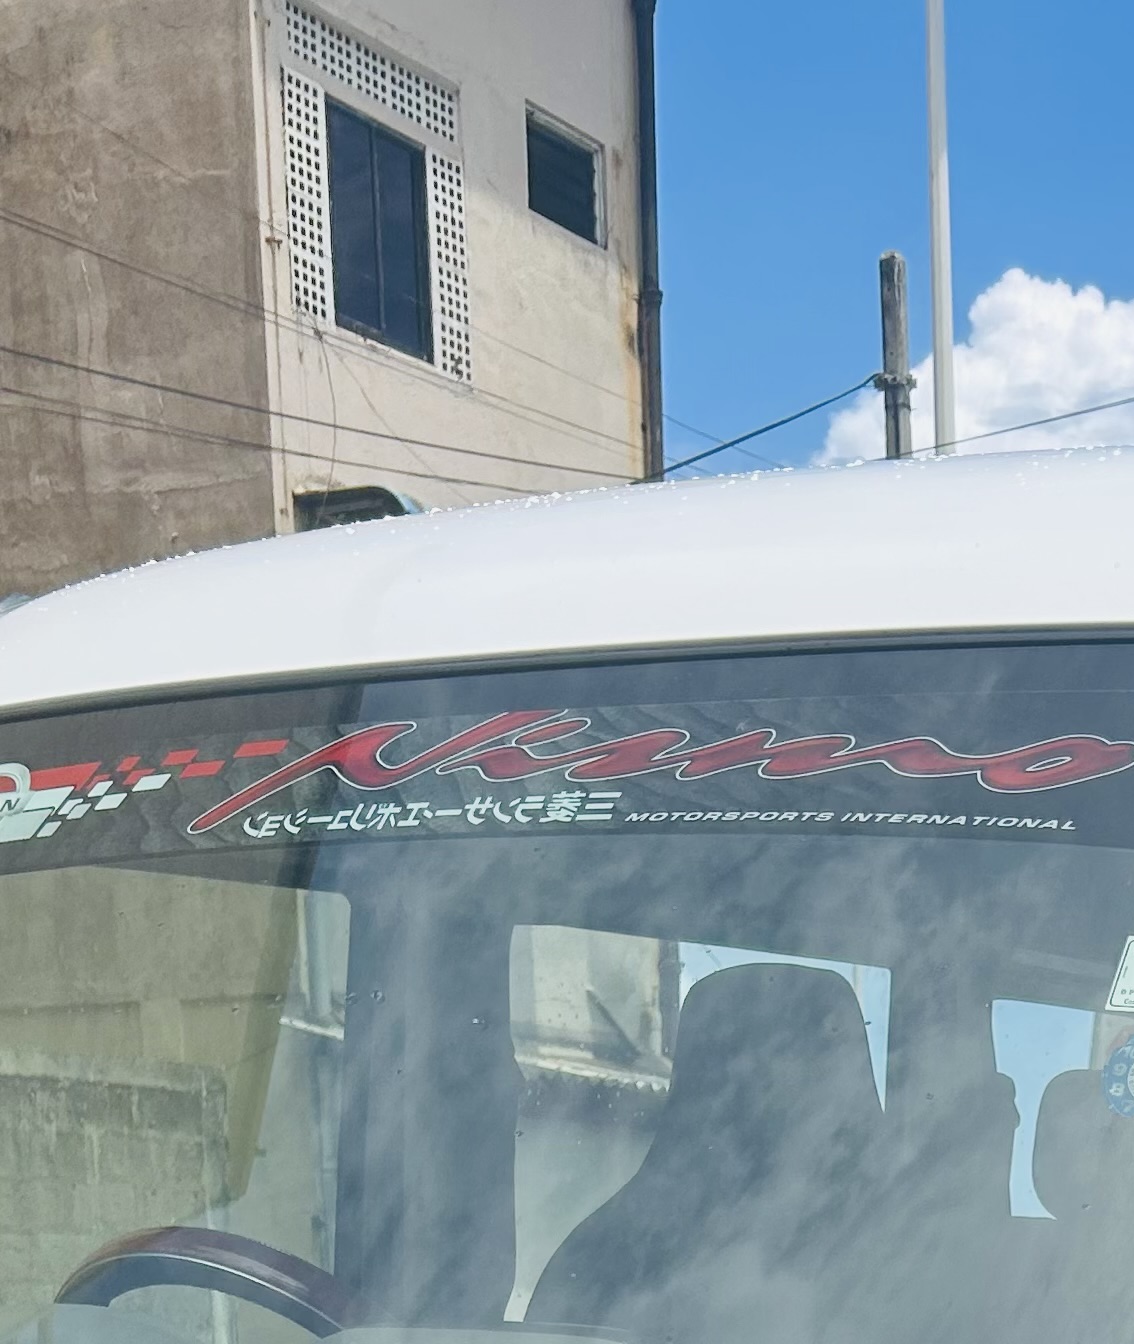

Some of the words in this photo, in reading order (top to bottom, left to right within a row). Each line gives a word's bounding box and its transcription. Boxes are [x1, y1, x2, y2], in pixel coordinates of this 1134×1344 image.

[624, 811, 834, 823] MOTORSPORTS
[841, 812, 1077, 830] INTERNATIONAL
[1113, 1063, 1128, 1076] 9
